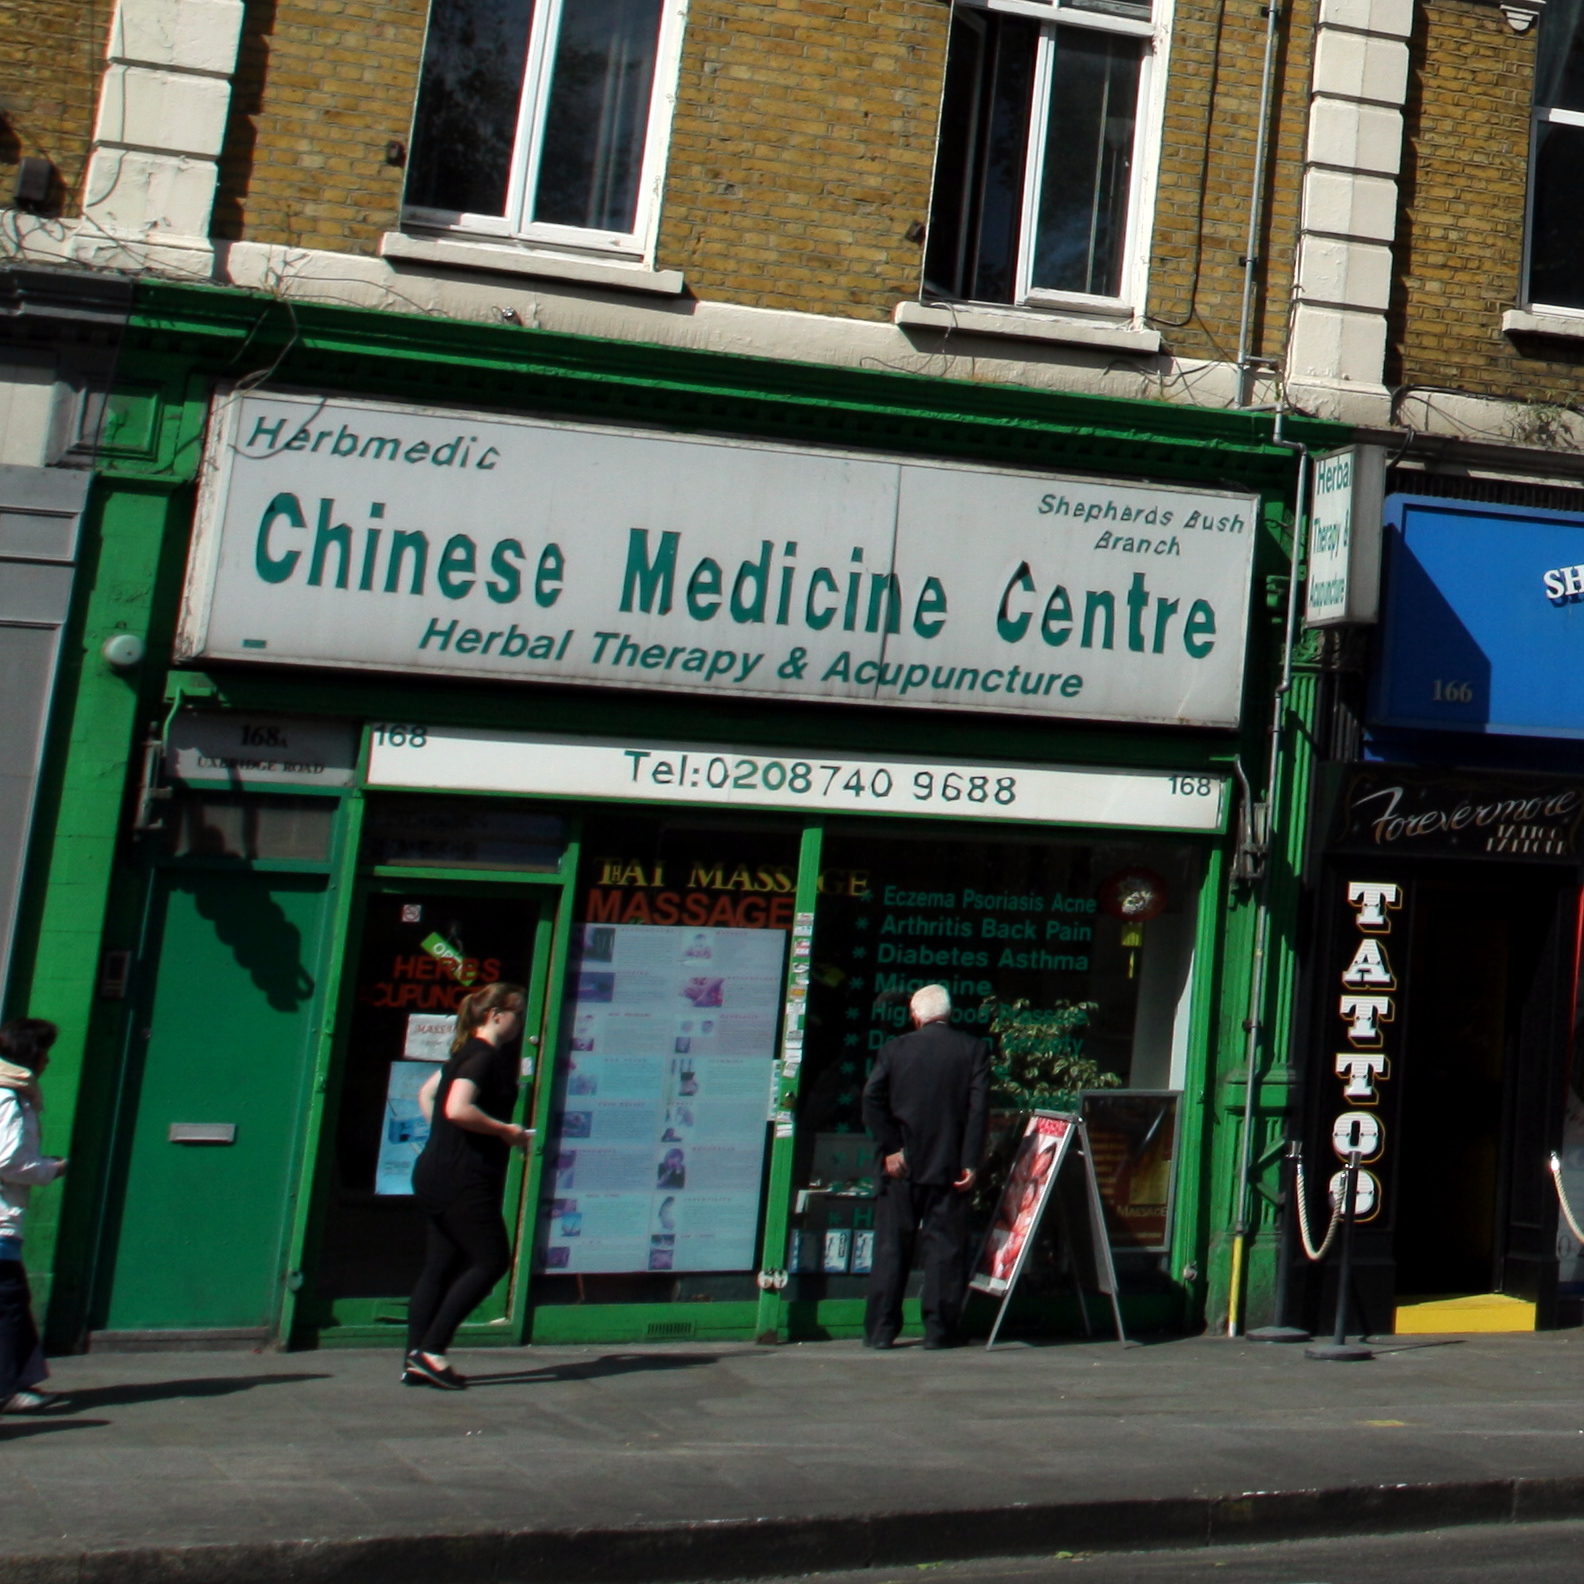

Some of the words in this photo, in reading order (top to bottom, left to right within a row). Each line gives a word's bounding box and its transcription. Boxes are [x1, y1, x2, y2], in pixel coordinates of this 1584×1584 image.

[245, 416, 501, 470] Herbmedic
[1037, 493, 1173, 528] Shepherds
[1184, 509, 1245, 534] Bush
[1094, 530, 1182, 557] Branch
[254, 492, 565, 608] Chinese
[619, 527, 948, 639] Medicine
[996, 560, 1217, 659] Centre
[417, 617, 574, 662] Herbal
[592, 631, 764, 683] Therapy
[776, 646, 809, 680] &
[822, 650, 1085, 701] Acupuncture
[1431, 678, 1474, 705] 166
[374, 722, 429, 748] 168
[198, 756, 278, 773] UXBRIDGE
[282, 761, 326, 774] ROAD
[912, 770, 1018, 806] 9688
[1168, 773, 1212, 798] 168
[1351, 785, 1582, 845] Forevermore
[687, 860, 872, 897] MASSGE
[584, 887, 797, 930] MASSAGE
[883, 884, 957, 909] Eczema
[962, 888, 1046, 914] Psoriasis
[1051, 892, 1099, 916] Acne
[879, 914, 974, 938] Arthritis
[980, 917, 1039, 941] Back
[1045, 919, 1093, 943] Pain
[392, 954, 502, 982] HERBS
[876, 942, 990, 968] Diabetes
[997, 946, 1090, 972] Asthma
[870, 1000, 909, 1027] Hig
[950, 1002, 992, 1024] ood
[1328, 880, 1403, 1223] TATTOO
